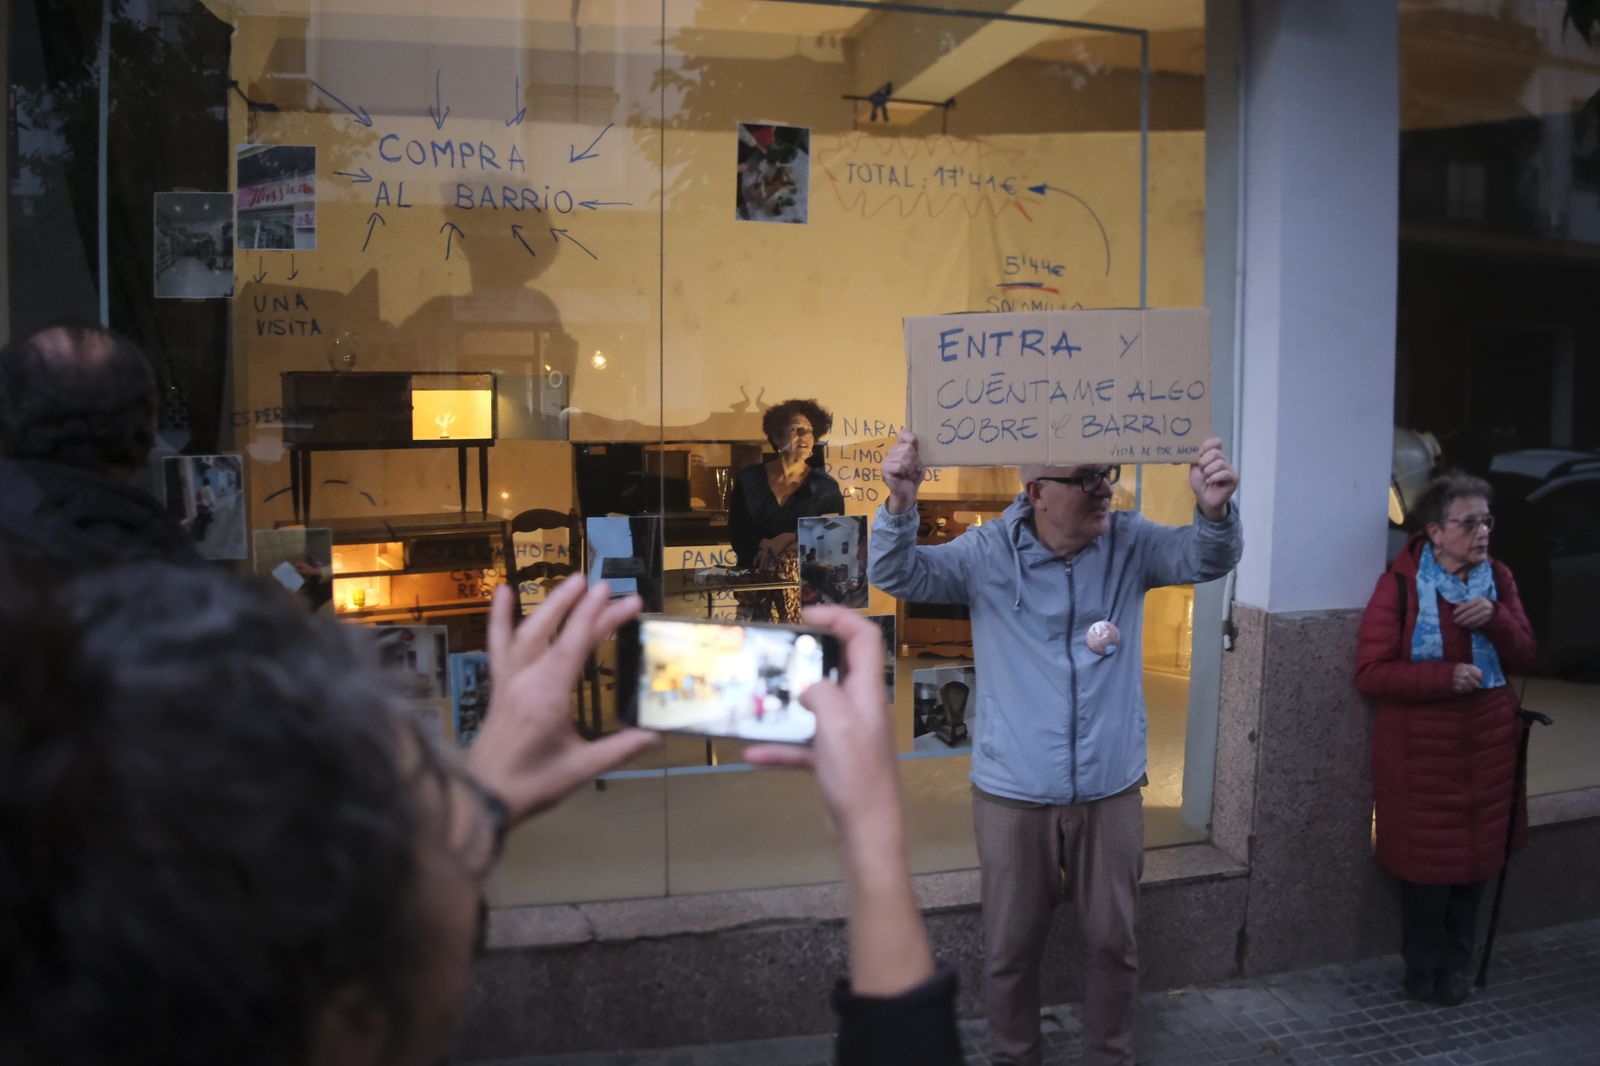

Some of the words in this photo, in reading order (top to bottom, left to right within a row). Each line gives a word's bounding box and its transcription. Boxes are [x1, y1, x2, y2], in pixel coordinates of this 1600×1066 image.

[378, 133, 526, 172] COMPRA
[375, 181, 413, 208] AL
[253, 293, 309, 313] UNA
[938, 327, 1082, 362] ENTRA
[1118, 331, 1141, 359] Y
[936, 371, 1116, 409] CUÉNTAME
[1127, 379, 1206, 402] ALGO
[843, 417, 904, 437] NARA
[936, 416, 1039, 445] SOBRE
[1081, 413, 1192, 438] BARRIO
[840, 443, 887, 464] LIMÓ
[838, 465, 885, 482] CABE
